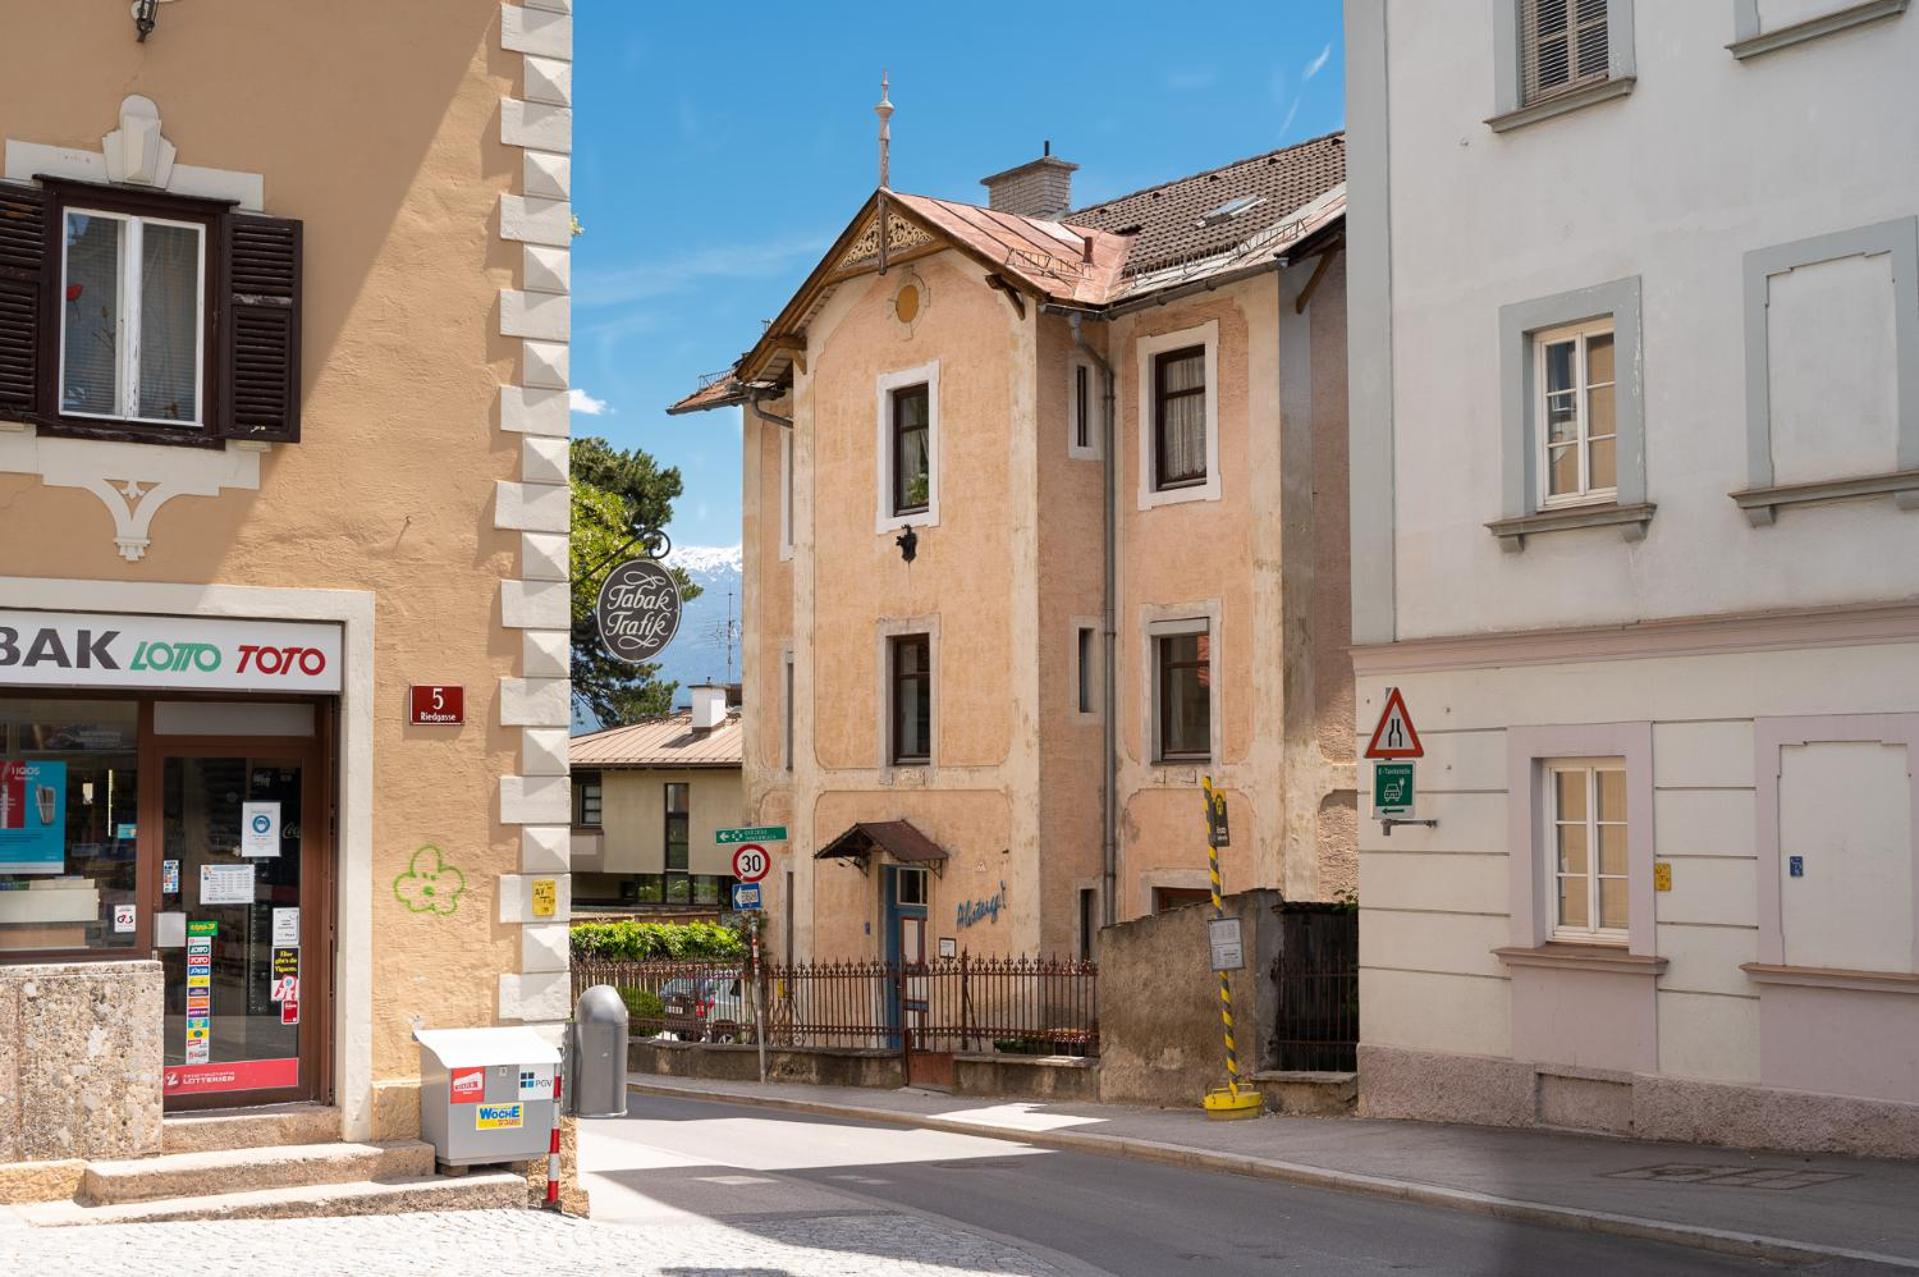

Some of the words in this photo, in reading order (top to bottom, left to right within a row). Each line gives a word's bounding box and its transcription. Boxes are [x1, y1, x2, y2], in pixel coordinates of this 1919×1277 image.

[607, 584, 674, 612] Tabak
[605, 611, 671, 638] Trafik
[129, 640, 223, 673] LOTTO
[235, 644, 327, 676] TOTO
[432, 687, 444, 710] 5
[420, 711, 456, 722] Riedgasse
[741, 854, 762, 873] 30
[183, 1075, 235, 1085] LOTTERIEN
[535, 1079, 553, 1088] PGV
